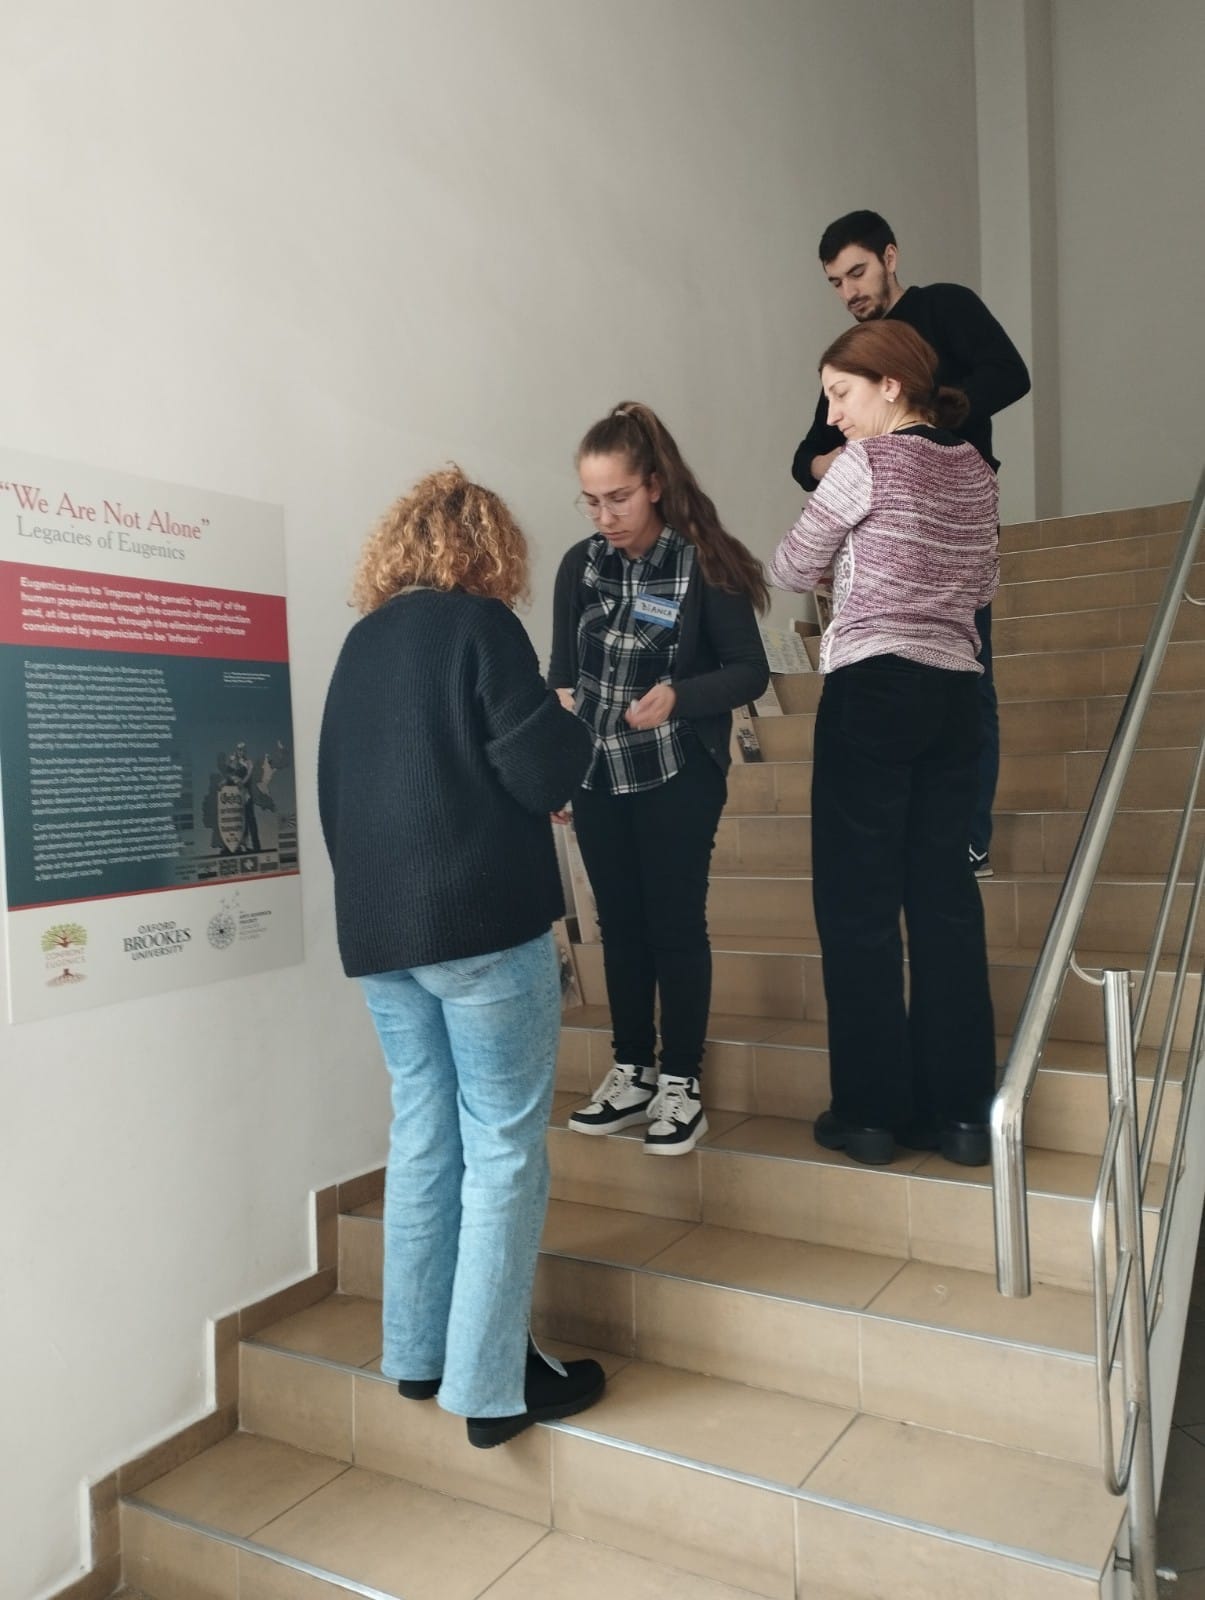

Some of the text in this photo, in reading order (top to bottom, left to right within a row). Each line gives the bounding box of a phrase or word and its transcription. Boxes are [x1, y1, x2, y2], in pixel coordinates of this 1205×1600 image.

[55, 492, 97, 522] Are
[103, 500, 141, 530] Not
[16, 515, 186, 561] Legacies of Eugenics
[20, 577, 66, 591] Eugenics
[144, 592, 160, 602] the
[20, 591, 57, 604] human
[57, 597, 109, 611] population
[137, 920, 177, 934] OXFORD
[122, 927, 193, 953] BROOKES
[131, 943, 183, 961] UNIVERSITY
